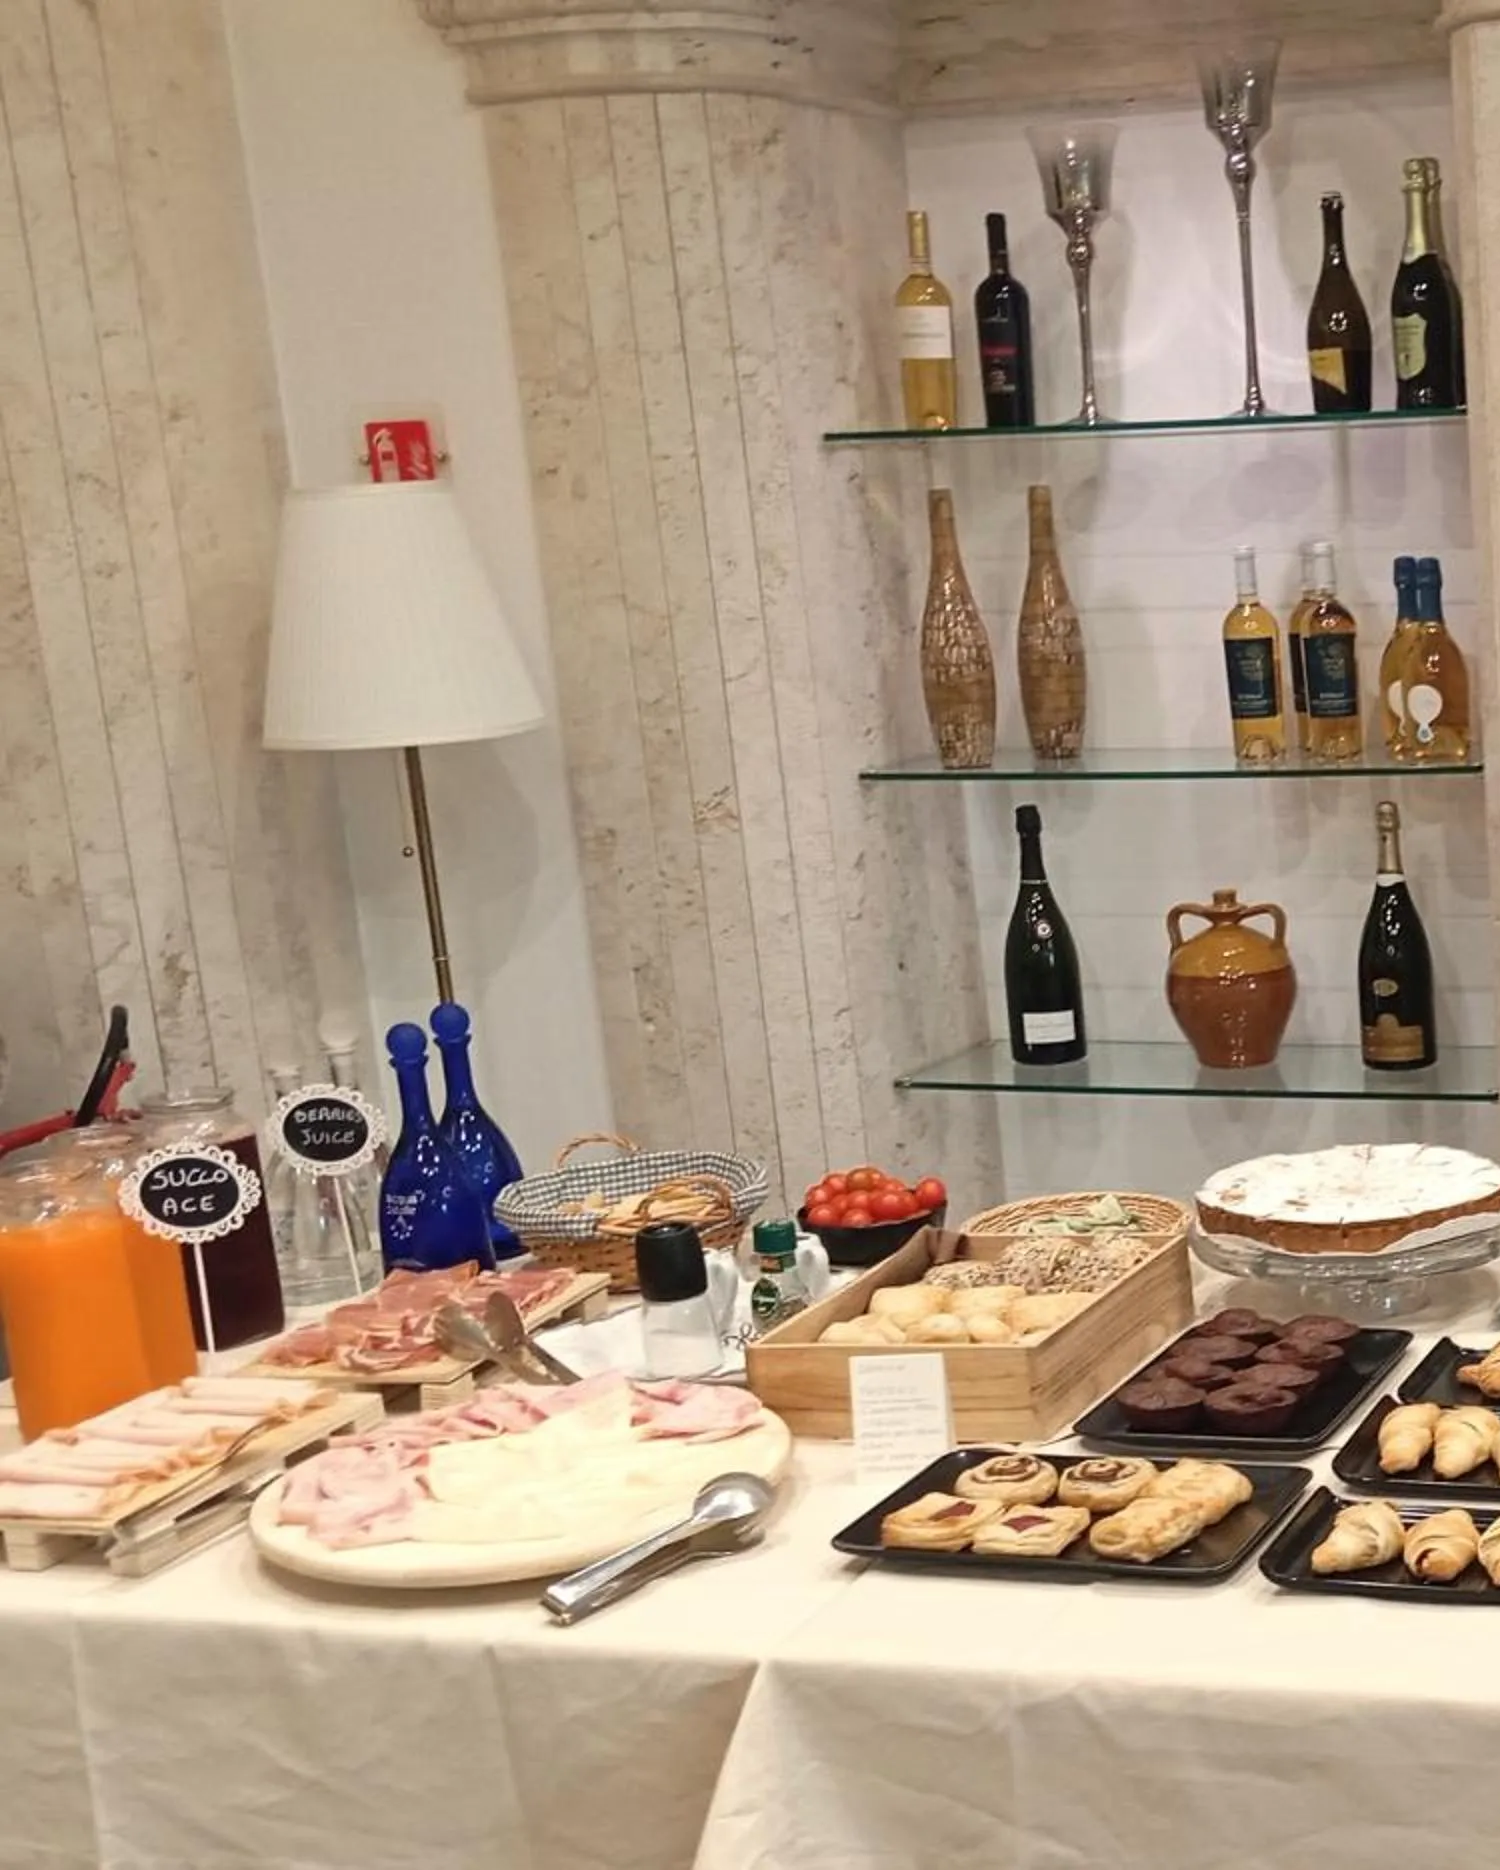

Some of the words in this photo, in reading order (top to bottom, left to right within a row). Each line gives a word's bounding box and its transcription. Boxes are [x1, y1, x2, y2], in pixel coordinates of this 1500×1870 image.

[301, 1128, 355, 1145] JUICE
[149, 1168, 229, 1191] SUCCO
[162, 1194, 216, 1217] ACE
